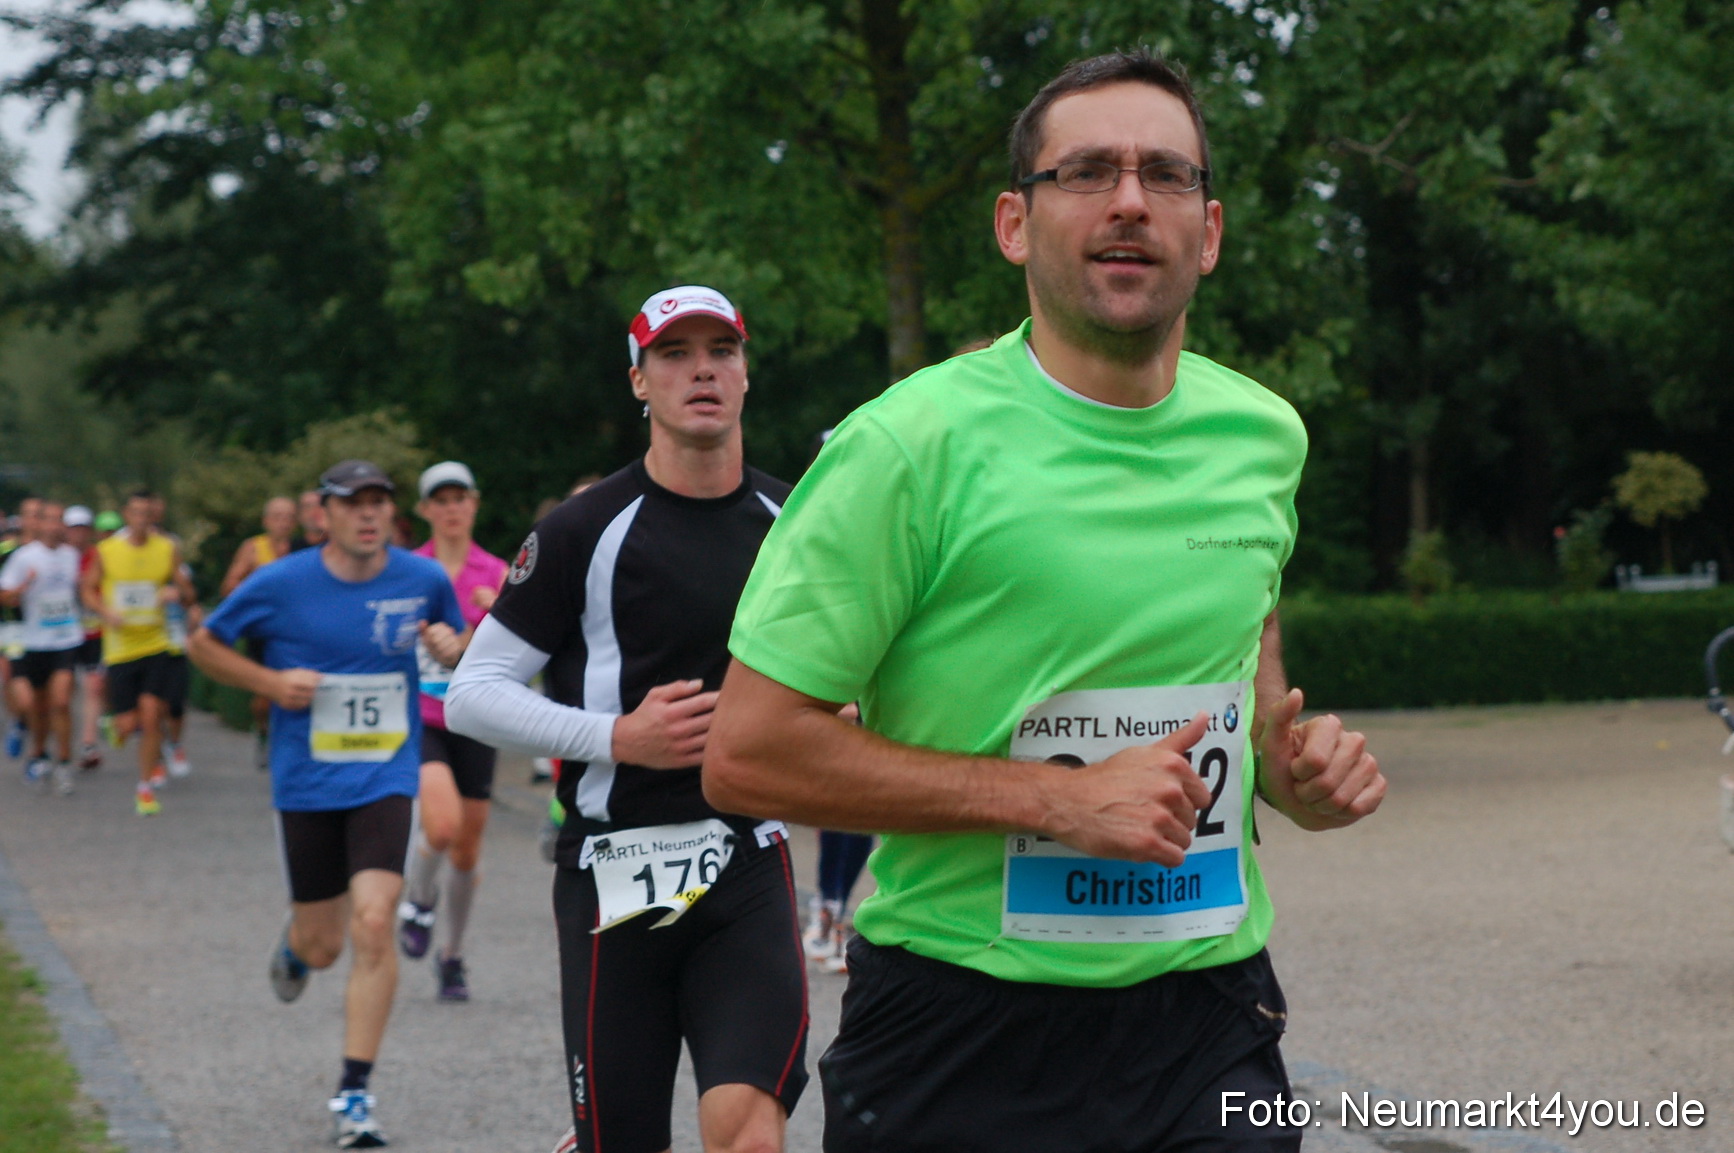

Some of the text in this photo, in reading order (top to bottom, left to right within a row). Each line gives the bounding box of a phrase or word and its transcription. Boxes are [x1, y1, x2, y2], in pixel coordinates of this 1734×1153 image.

[343, 695, 380, 727] 15
[1019, 716, 1108, 738] PARTL
[596, 842, 649, 864] PARTL
[1016, 838, 1026, 853] B
[1065, 869, 1202, 906] Christian
